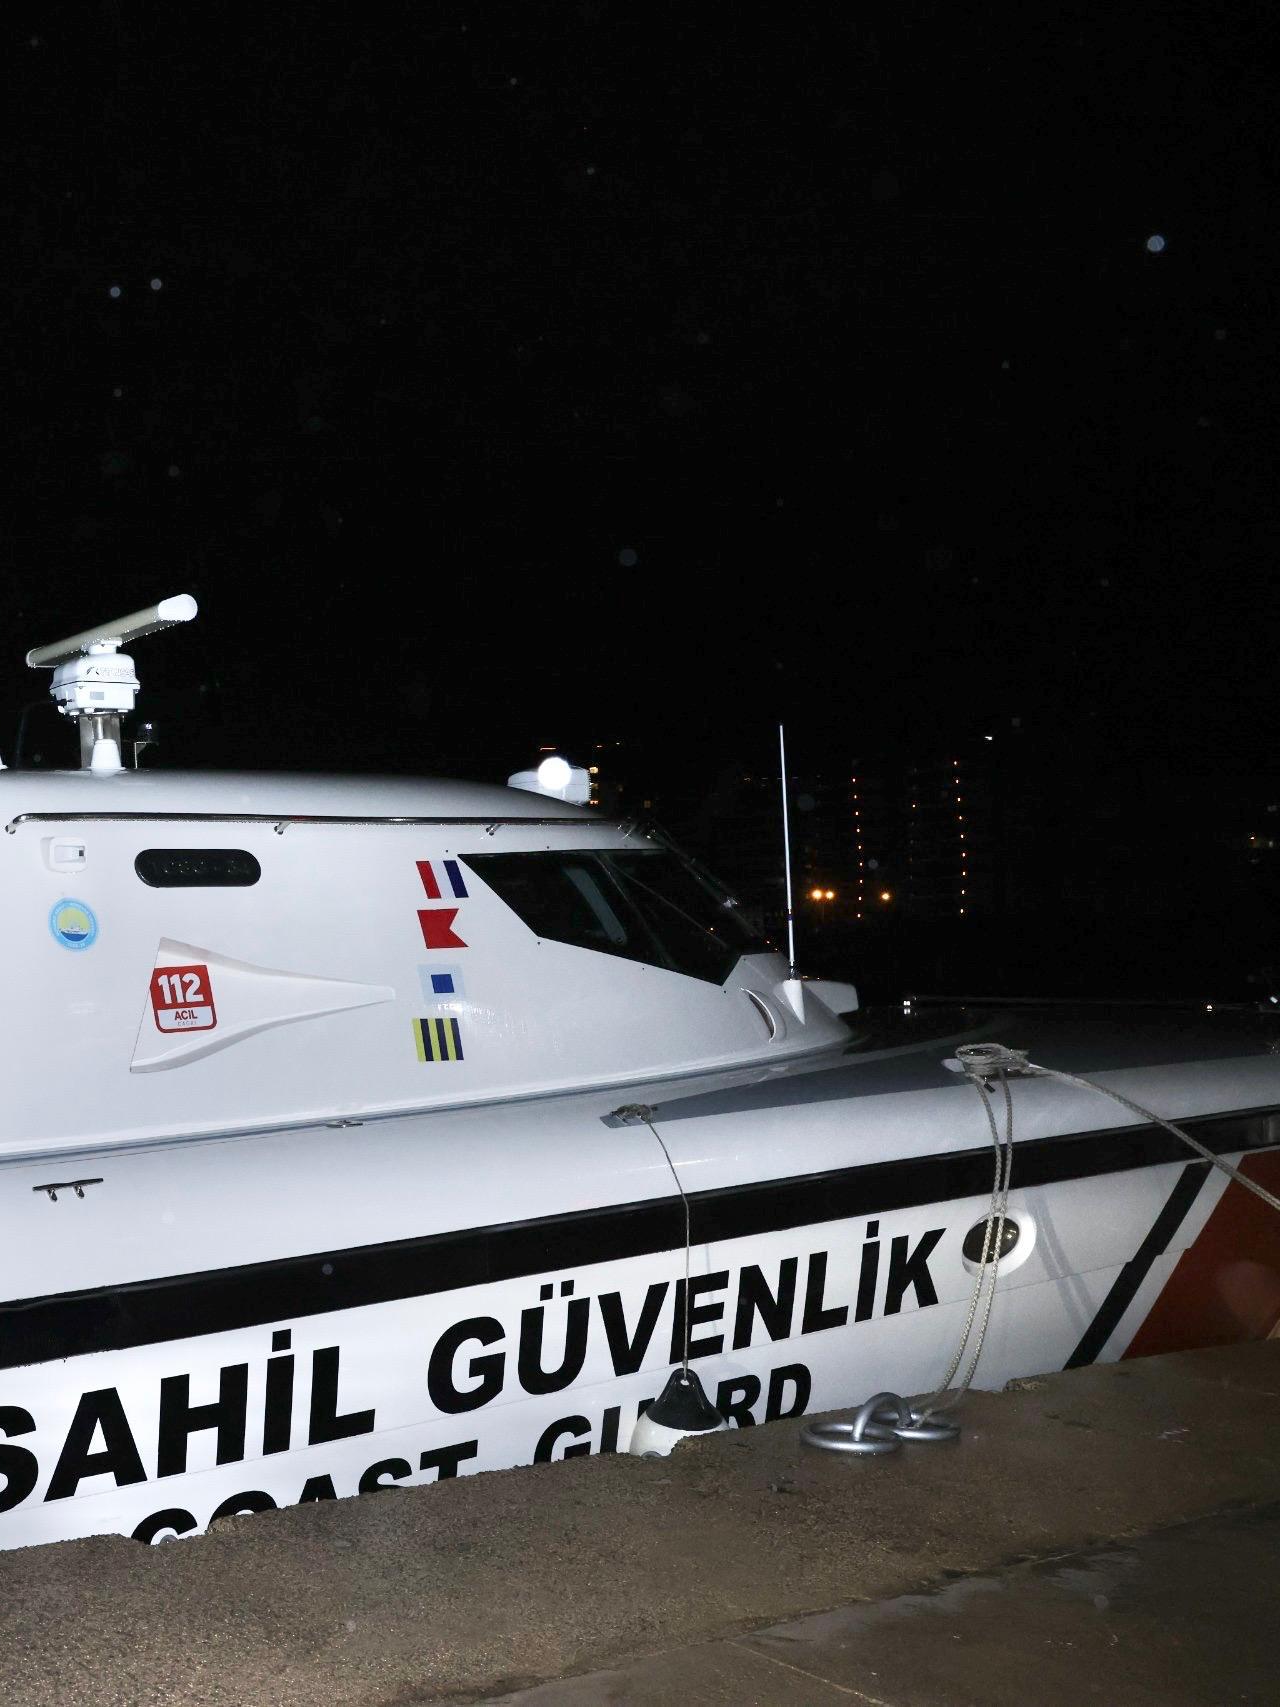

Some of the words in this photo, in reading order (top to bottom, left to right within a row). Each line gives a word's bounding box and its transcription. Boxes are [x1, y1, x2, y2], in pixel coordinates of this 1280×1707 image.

[157, 972, 205, 1005] 112
[427, 1219, 947, 1415] GÜVENLİK
[533, 1363, 812, 1465] GRD
